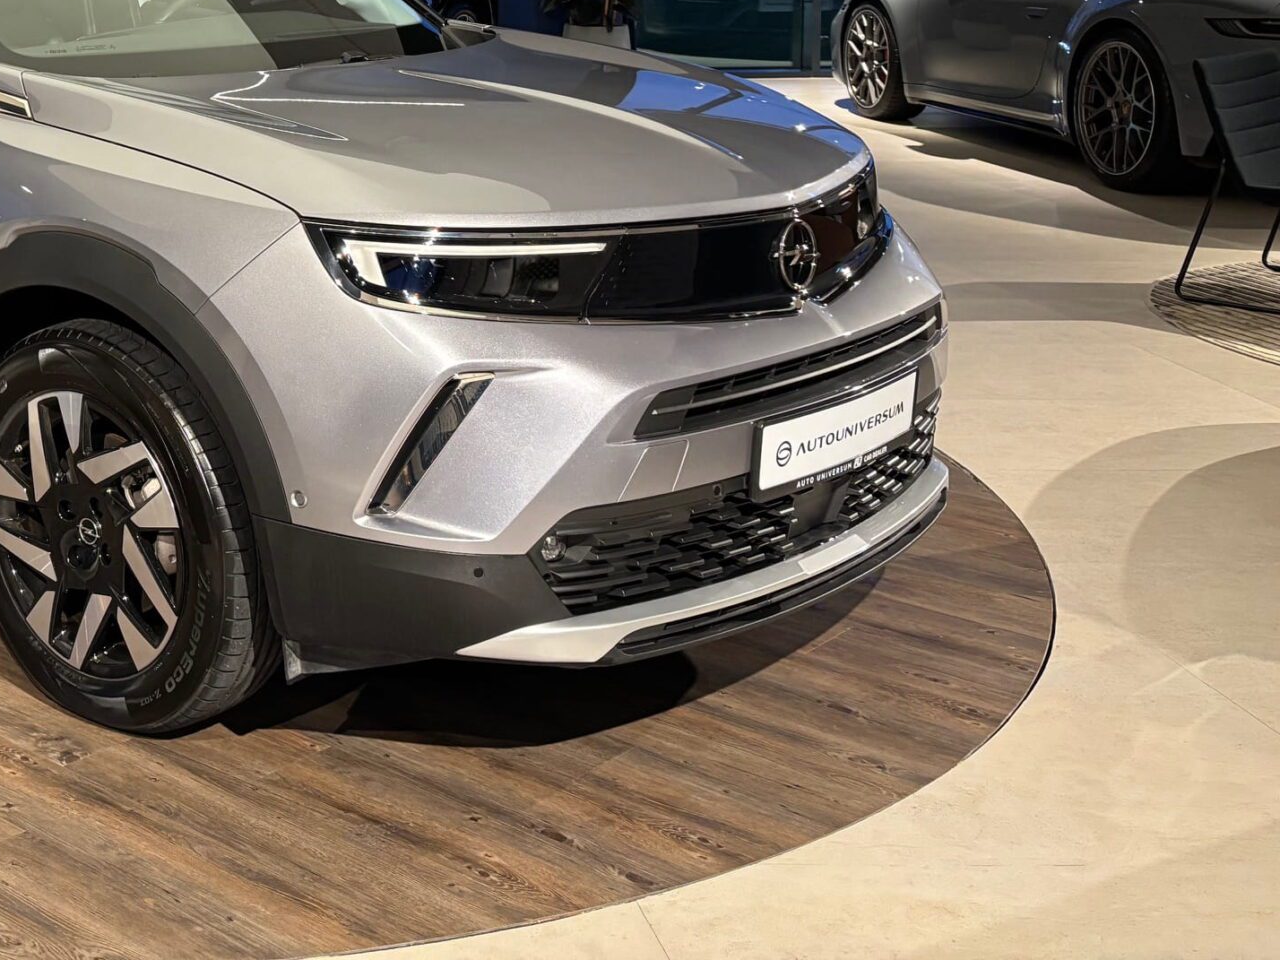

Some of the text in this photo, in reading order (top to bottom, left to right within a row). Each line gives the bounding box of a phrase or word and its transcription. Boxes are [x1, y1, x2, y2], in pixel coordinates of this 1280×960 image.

[796, 401, 903, 456] AUTOUNIVERSUM
[796, 476, 815, 489] AUTO
[816, 461, 853, 482] UNIVERSUM
